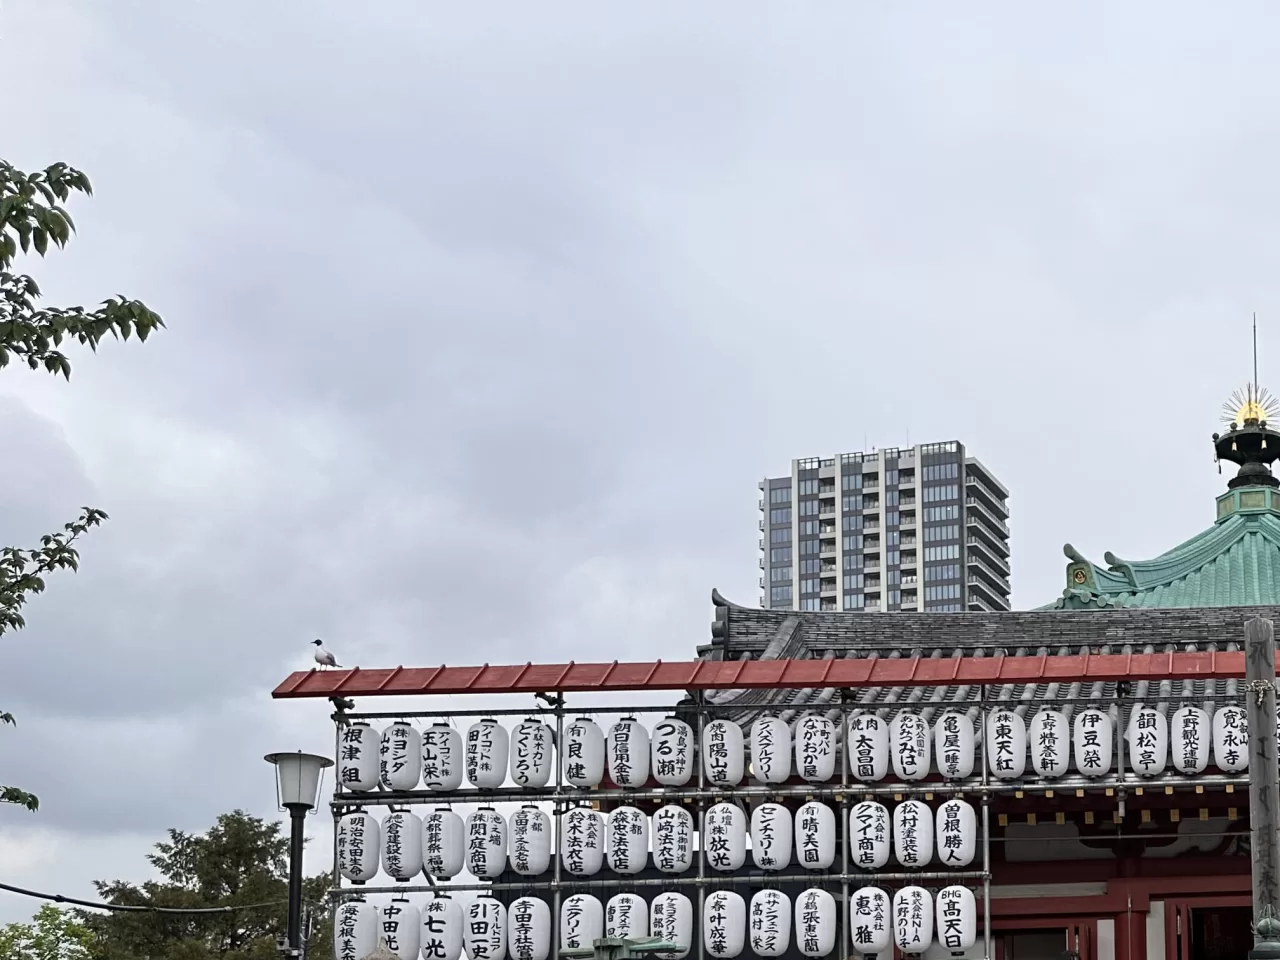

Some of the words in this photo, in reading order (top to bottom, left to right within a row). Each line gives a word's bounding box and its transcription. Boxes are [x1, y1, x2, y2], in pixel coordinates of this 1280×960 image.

[391, 726, 411, 773] (株)ヨシダ
[566, 724, 586, 780] (有)良健
[656, 724, 676, 776] つる瀬
[675, 724, 690, 774] 湯島天神下
[708, 722, 730, 783] 焼肉陽山道
[801, 717, 819, 778] ながおか屋
[818, 719, 831, 756] 下町バル
[850, 717, 878, 732] 焼肉
[898, 714, 918, 777] あんみつみはし
[941, 715, 960, 776] 亀屋一睡亭
[994, 712, 1014, 771] (株)東天紅
[1039, 712, 1060, 771] 上野精養軒
[1135, 713, 1157, 771] 韻松亭
[1182, 708, 1200, 770] 上野観光連盟
[341, 727, 363, 784] 根津組
[422, 730, 443, 788] 玉山栄一
[515, 723, 533, 785] とくじろう
[612, 722, 633, 785] 朝日信用金庫
[855, 734, 875, 778] 太昌園
[488, 813, 502, 846] 池之端
[531, 811, 543, 832] 京都
[566, 810, 586, 874] 鈴木法衣店
[584, 813, 599, 849] 株式会社
[611, 810, 631, 871] 森忠法衣店
[630, 810, 643, 835] 京都
[720, 807, 732, 828] 仏壇
[756, 805, 777, 867] センチュリー(株)
[800, 804, 819, 865] (有)晴美園
[856, 803, 875, 866] クマイ商店
[874, 805, 887, 843] 株式会社
[899, 802, 919, 865] 松村塗装店
[337, 825, 348, 871] 上野支社
[348, 817, 366, 878] 明治安田生命
[708, 824, 732, 868] (株)放光
[873, 892, 886, 931] 株式会社
[940, 888, 961, 900] BHG
[383, 905, 402, 956] 中田光
[423, 902, 446, 960] (株)七光
[469, 904, 491, 960] 引田一史
[897, 895, 912, 950] 上野のり子
